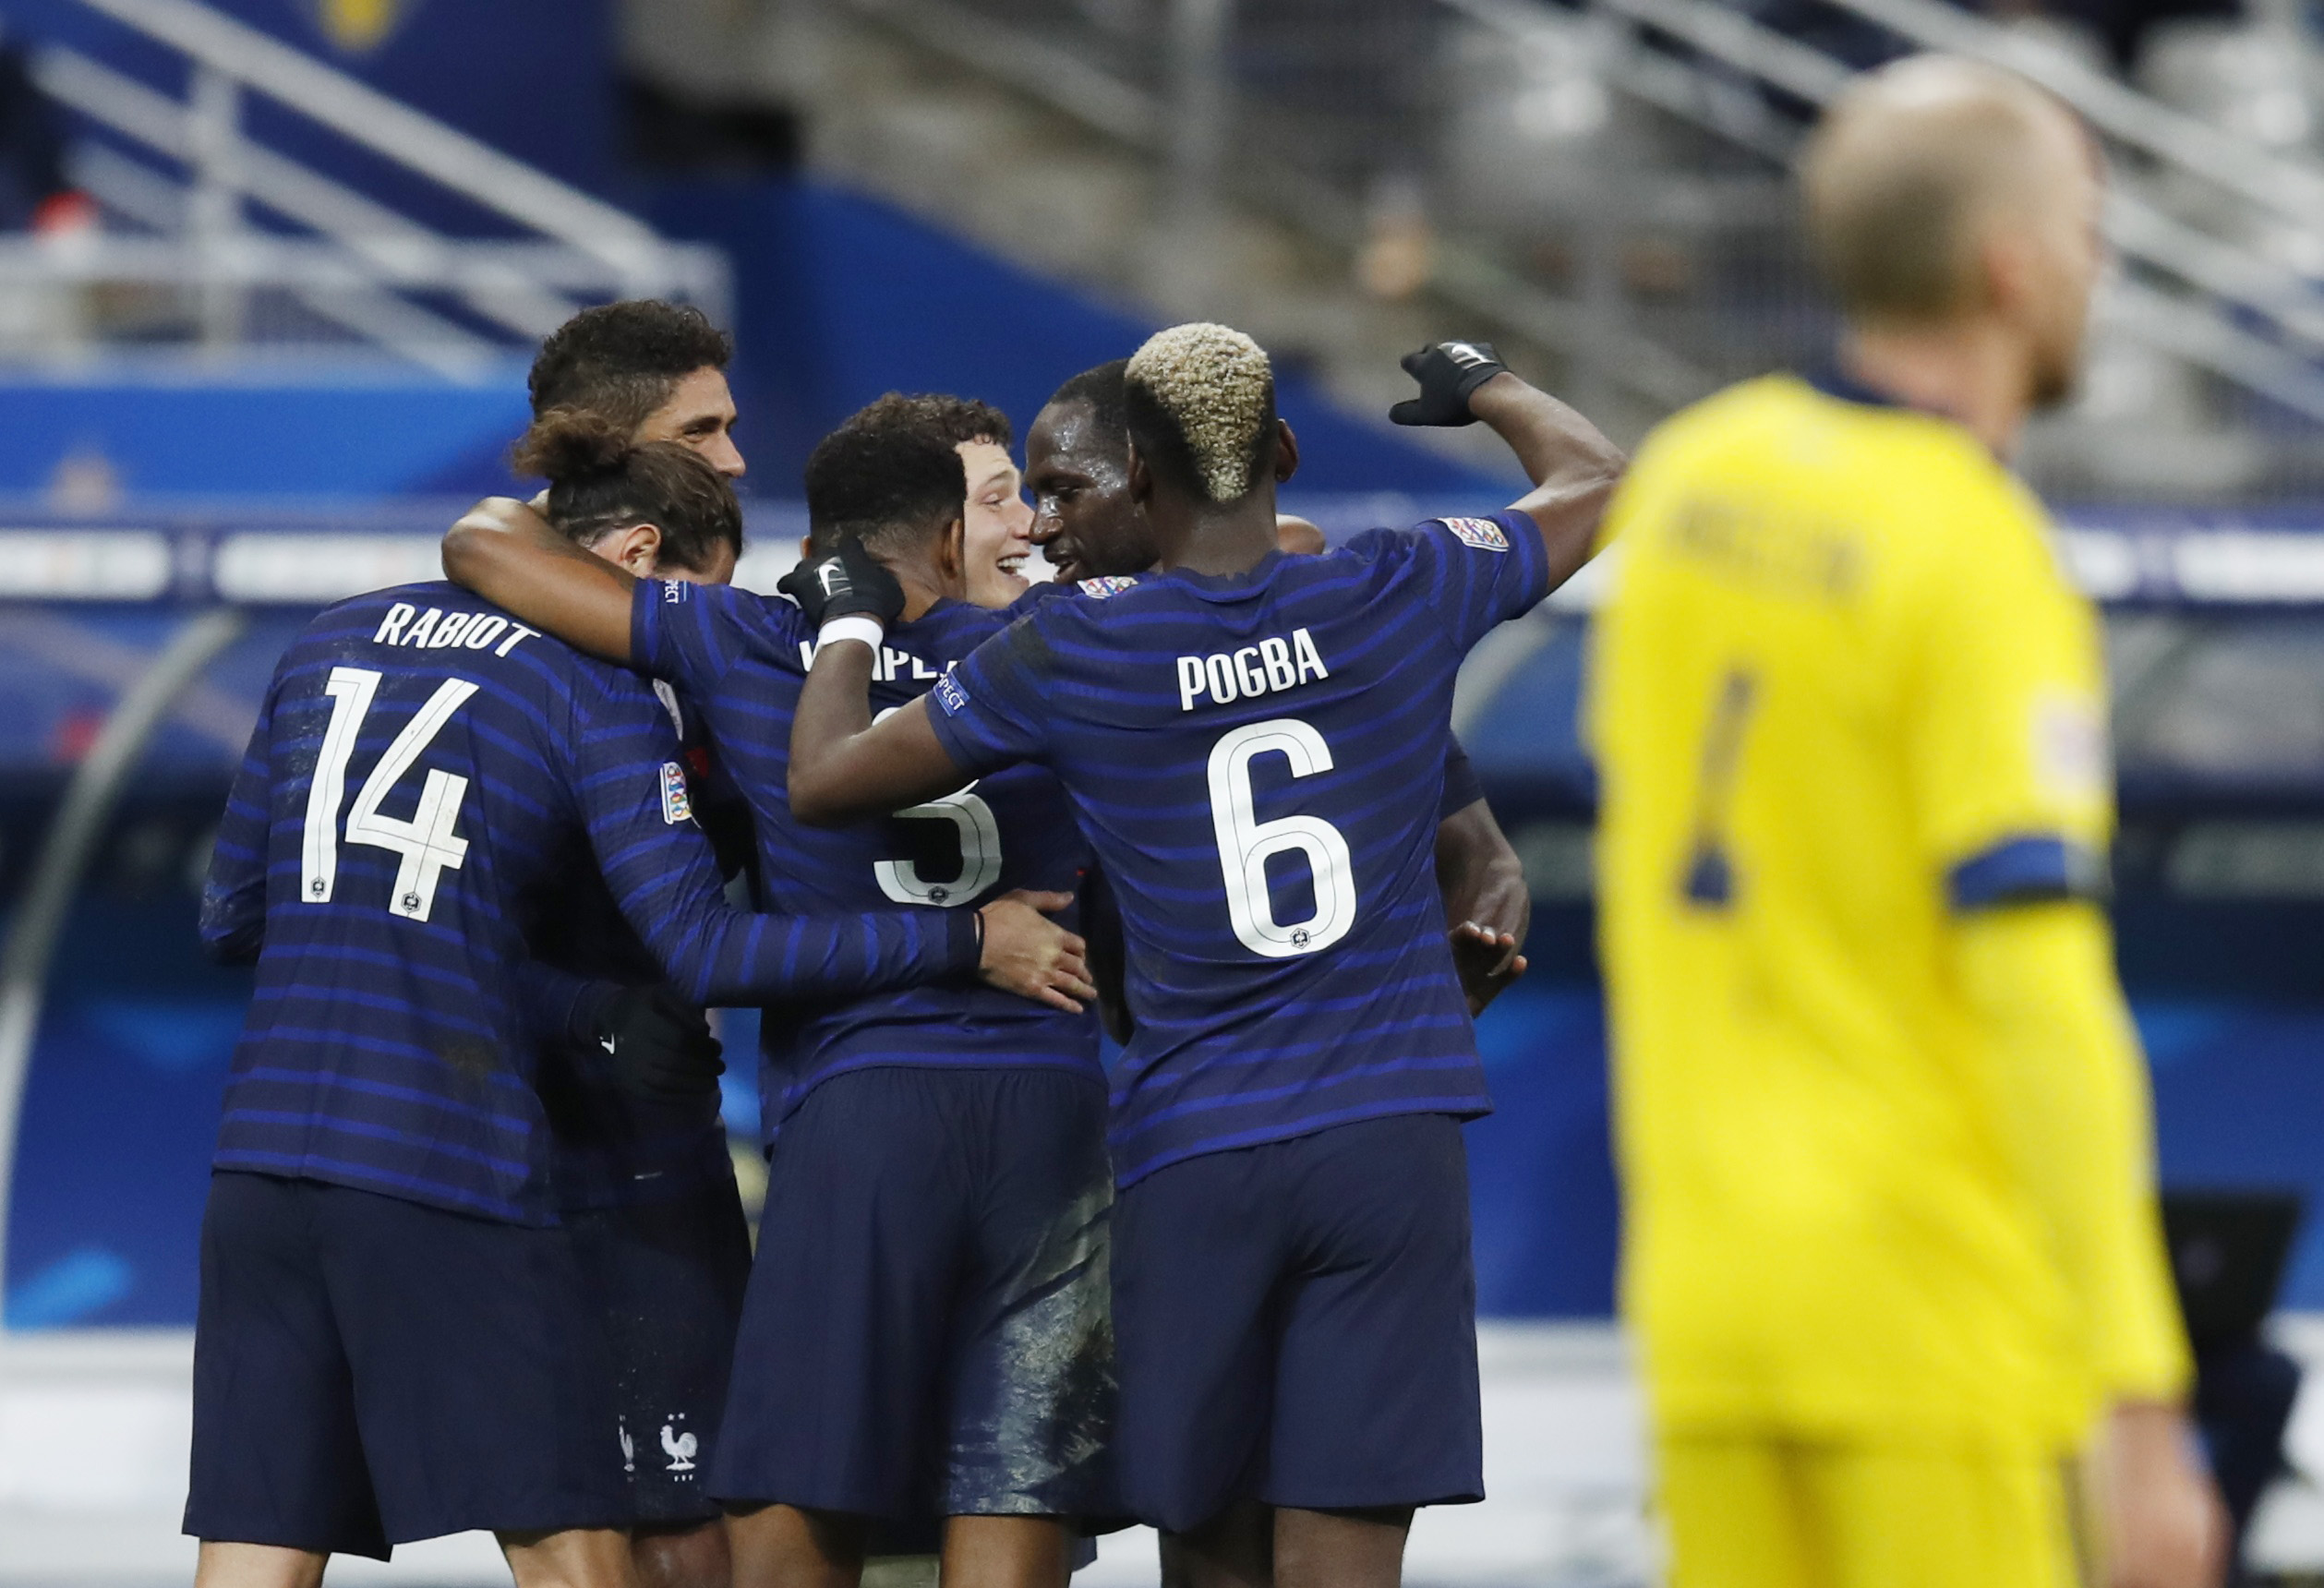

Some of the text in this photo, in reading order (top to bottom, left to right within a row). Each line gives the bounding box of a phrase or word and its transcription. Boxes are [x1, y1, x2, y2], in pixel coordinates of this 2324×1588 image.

[373, 602, 541, 658] RABIOT
[1177, 628, 1329, 711] POGBA
[301, 666, 479, 922] 14
[1207, 718, 1357, 958] 6
